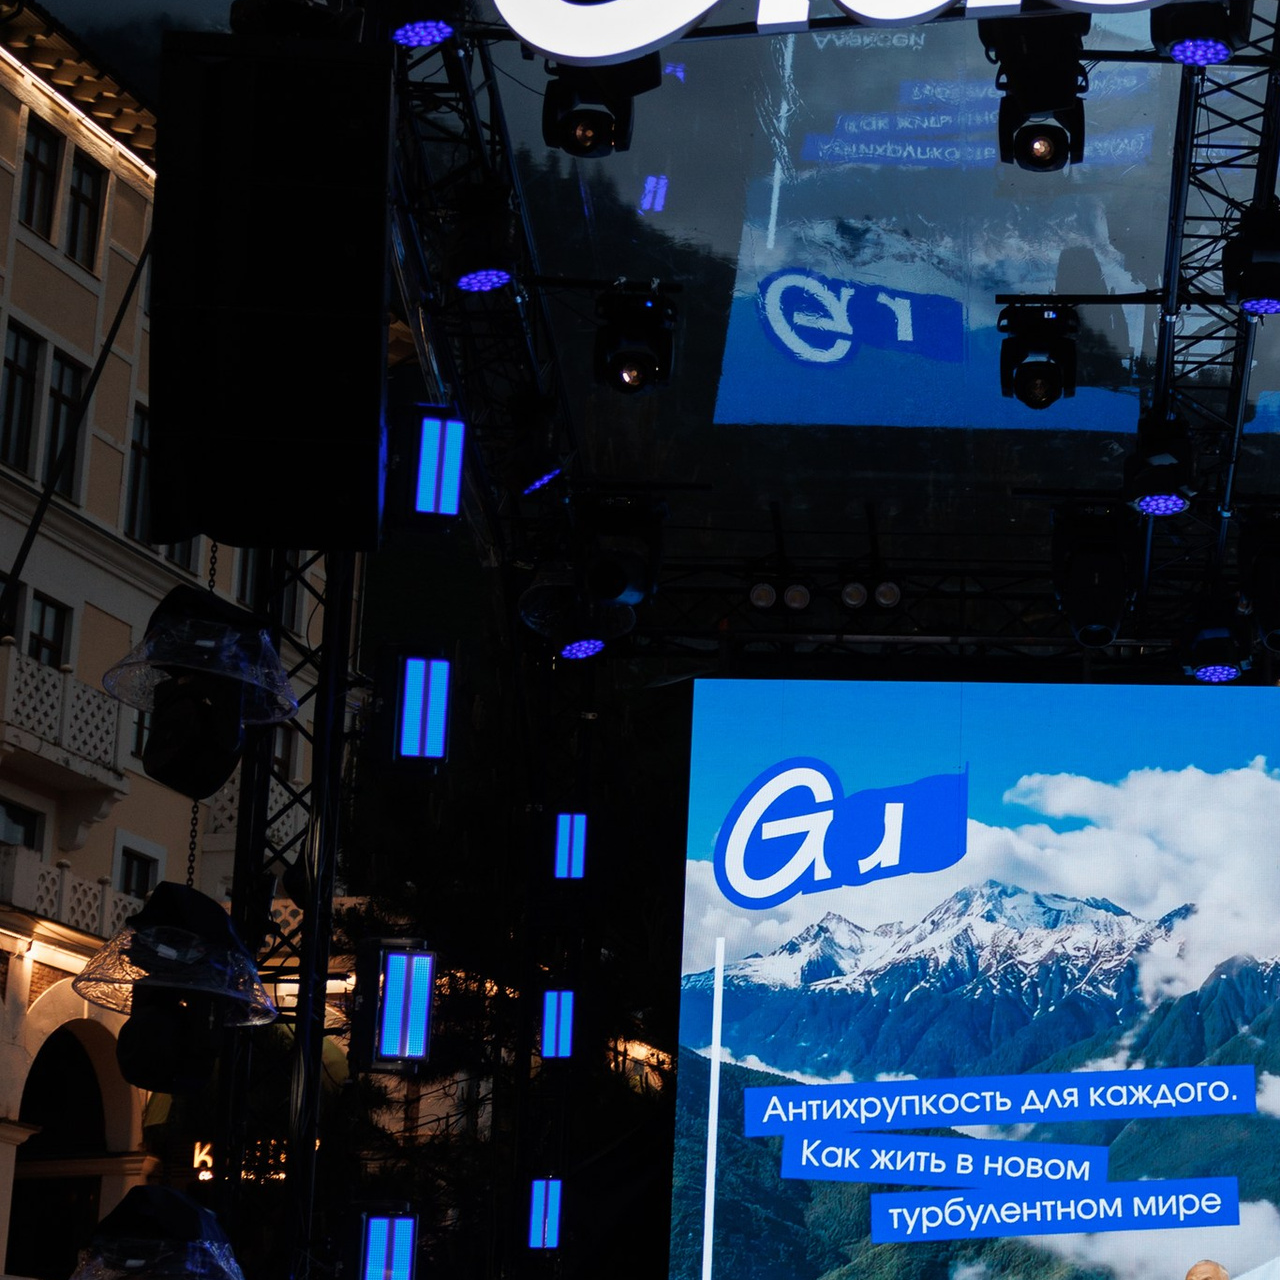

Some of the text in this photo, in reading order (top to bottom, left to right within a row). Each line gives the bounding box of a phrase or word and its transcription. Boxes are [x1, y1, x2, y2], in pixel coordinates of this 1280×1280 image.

[762, 1079, 1238, 1124] Антихрупкость для каждого.
[801, 1139, 1090, 1181] Как жить в новом
[888, 1192, 1223, 1235] турбулентном мире
